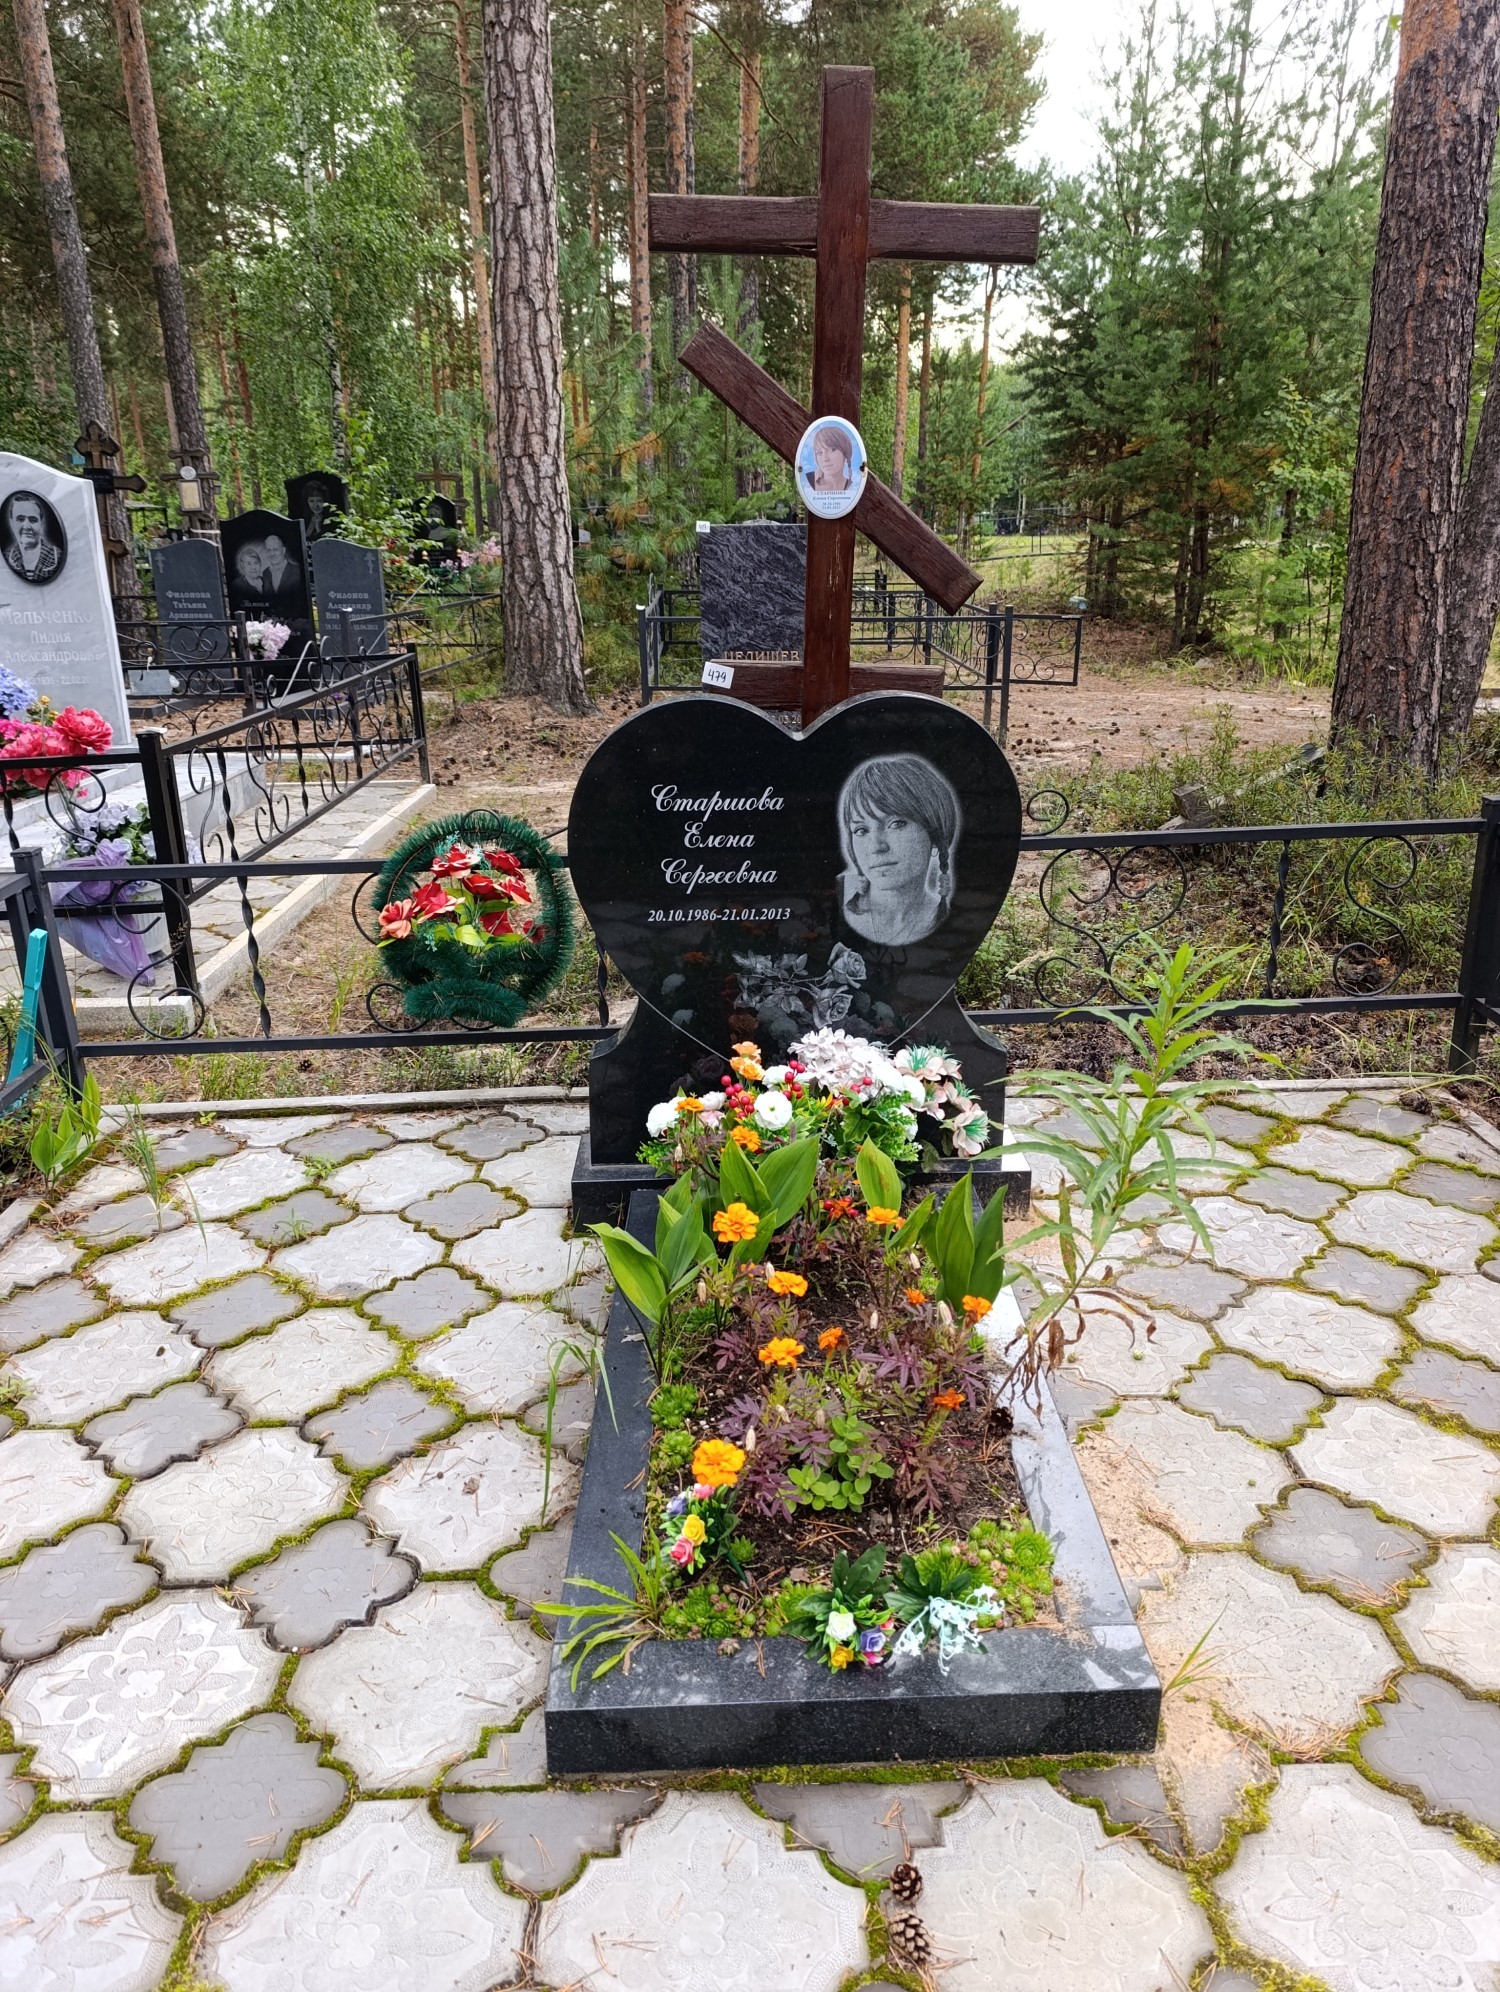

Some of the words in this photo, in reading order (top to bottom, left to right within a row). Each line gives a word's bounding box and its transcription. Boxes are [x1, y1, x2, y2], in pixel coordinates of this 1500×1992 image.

[166, 590, 211, 599] Филонова
[328, 591, 369, 599] Филонов
[172, 601, 207, 609] Татьяна
[327, 602, 372, 612] Александр
[1, 608, 93, 625] Мальченко
[30, 631, 72, 645] Лидия
[707, 668, 728, 684] 479
[651, 784, 785, 822] Старшова
[684, 820, 755, 848] Елена
[660, 858, 778, 894] Сергеевна
[648, 908, 791, 922] 20.10.1986-21.01.2013
